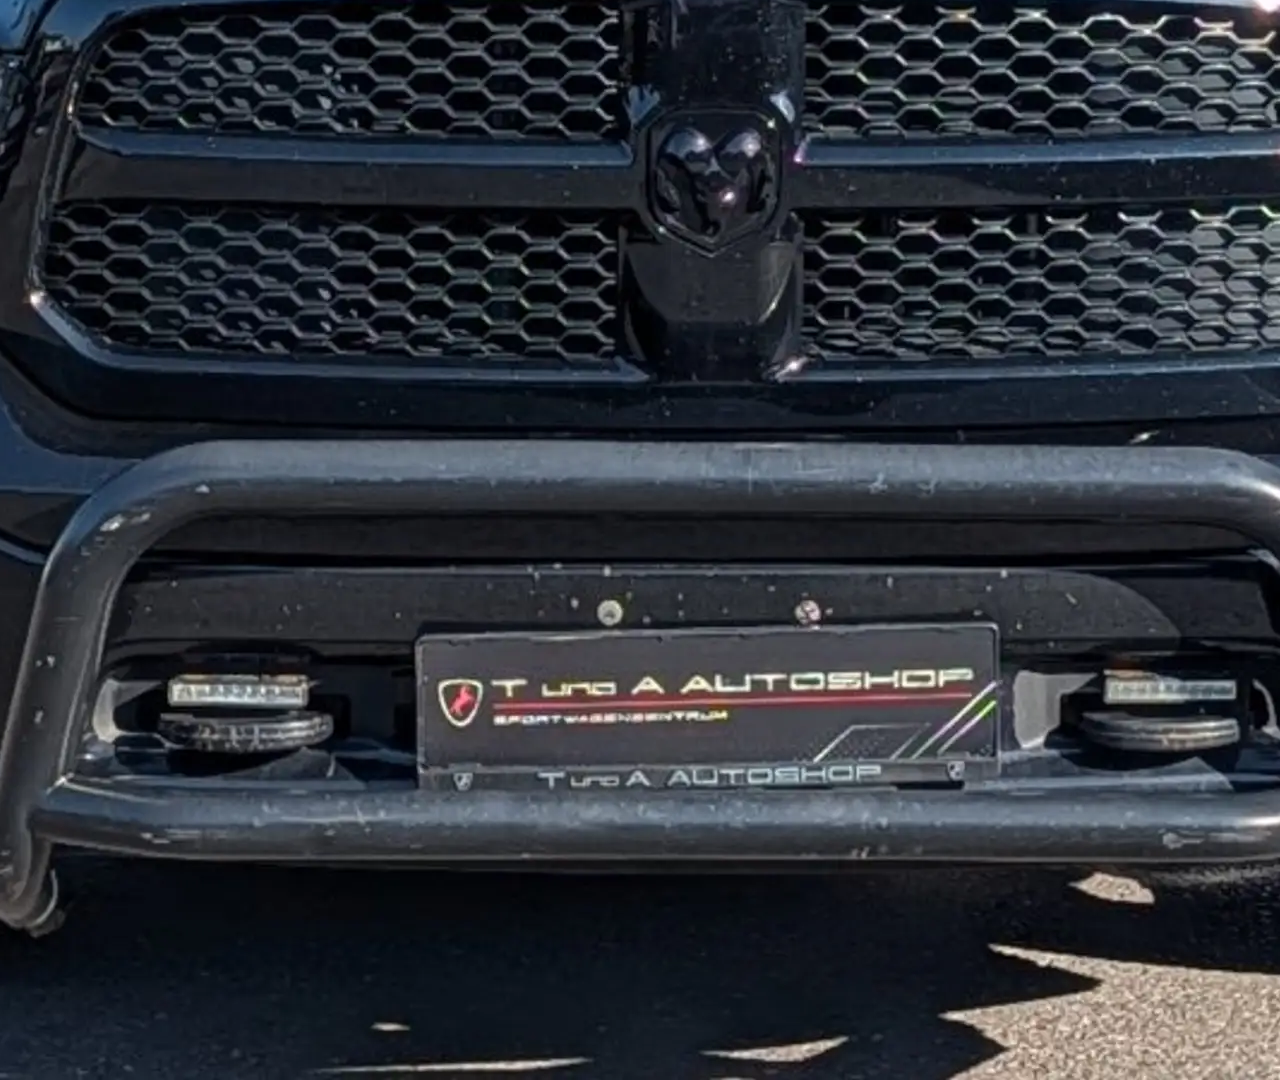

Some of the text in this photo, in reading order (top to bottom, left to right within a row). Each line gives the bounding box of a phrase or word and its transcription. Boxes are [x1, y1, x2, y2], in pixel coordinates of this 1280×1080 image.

[490, 678, 528, 698] T
[631, 676, 665, 694] A
[680, 668, 975, 693] AUTOSHOP
[537, 772, 565, 789] T
[626, 771, 651, 787] A
[667, 765, 882, 788] AUTOSHOP
